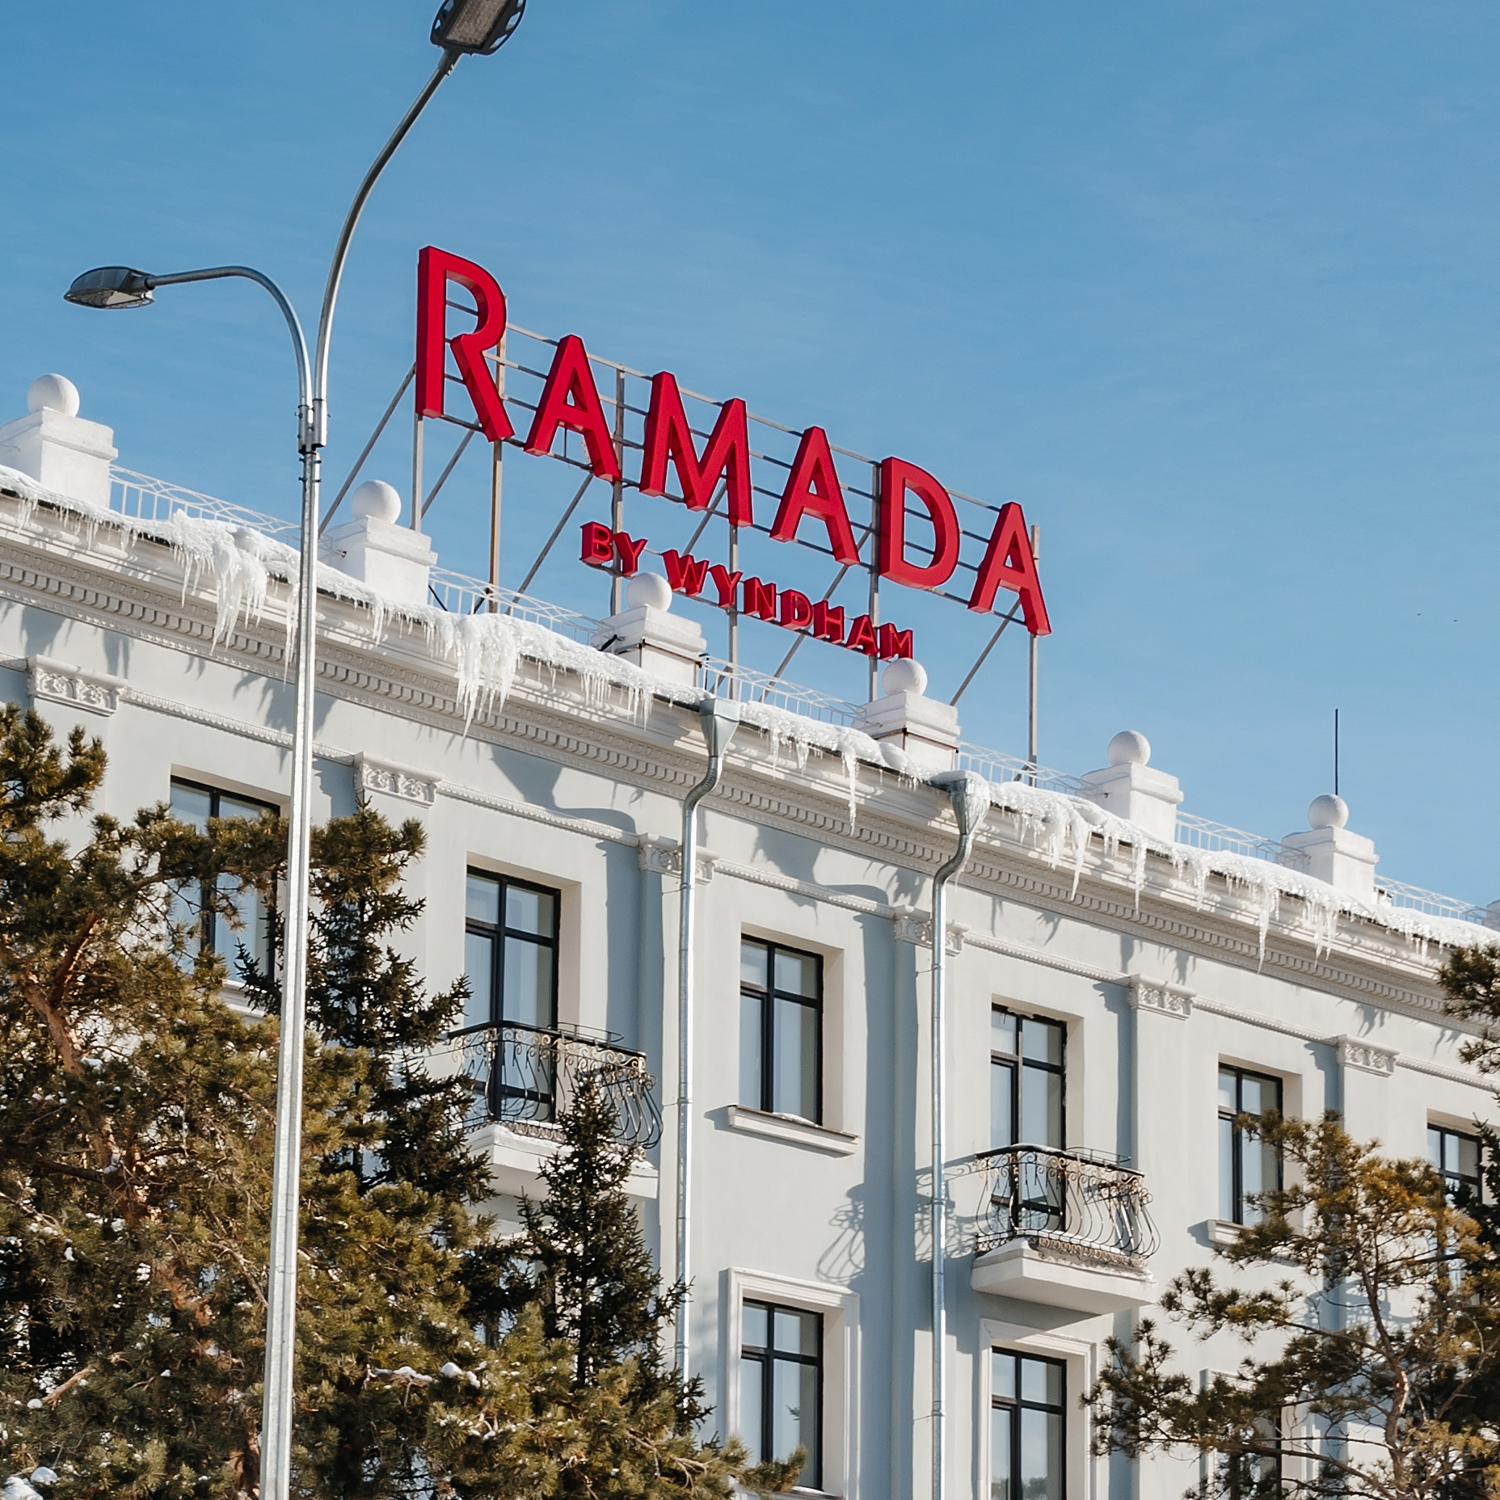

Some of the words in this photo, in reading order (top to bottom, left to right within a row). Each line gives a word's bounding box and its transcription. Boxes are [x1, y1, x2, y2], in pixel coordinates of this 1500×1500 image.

[416, 245, 1051, 636] RAMADA
[580, 521, 648, 576] BY
[662, 549, 913, 660] WYNDHAM
